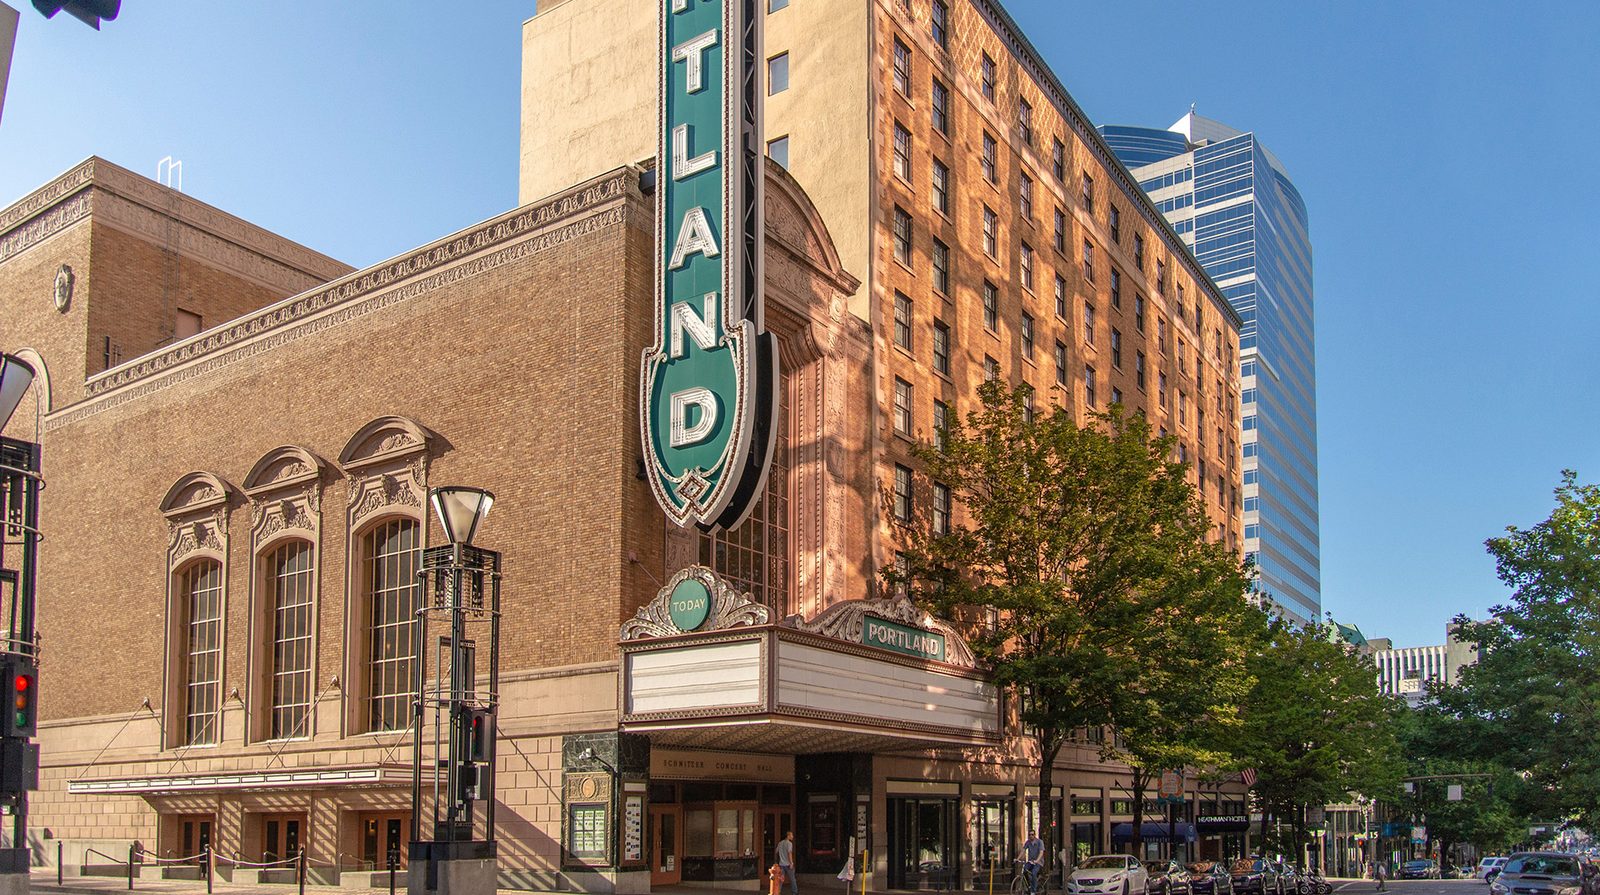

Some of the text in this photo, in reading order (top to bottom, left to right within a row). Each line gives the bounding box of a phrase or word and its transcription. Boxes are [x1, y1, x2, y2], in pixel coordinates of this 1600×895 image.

[668, 0, 721, 448] TLAND
[672, 598, 706, 613] TODAY
[868, 622, 941, 656] PORTLAND
[715, 762, 747, 771] CONCERT
